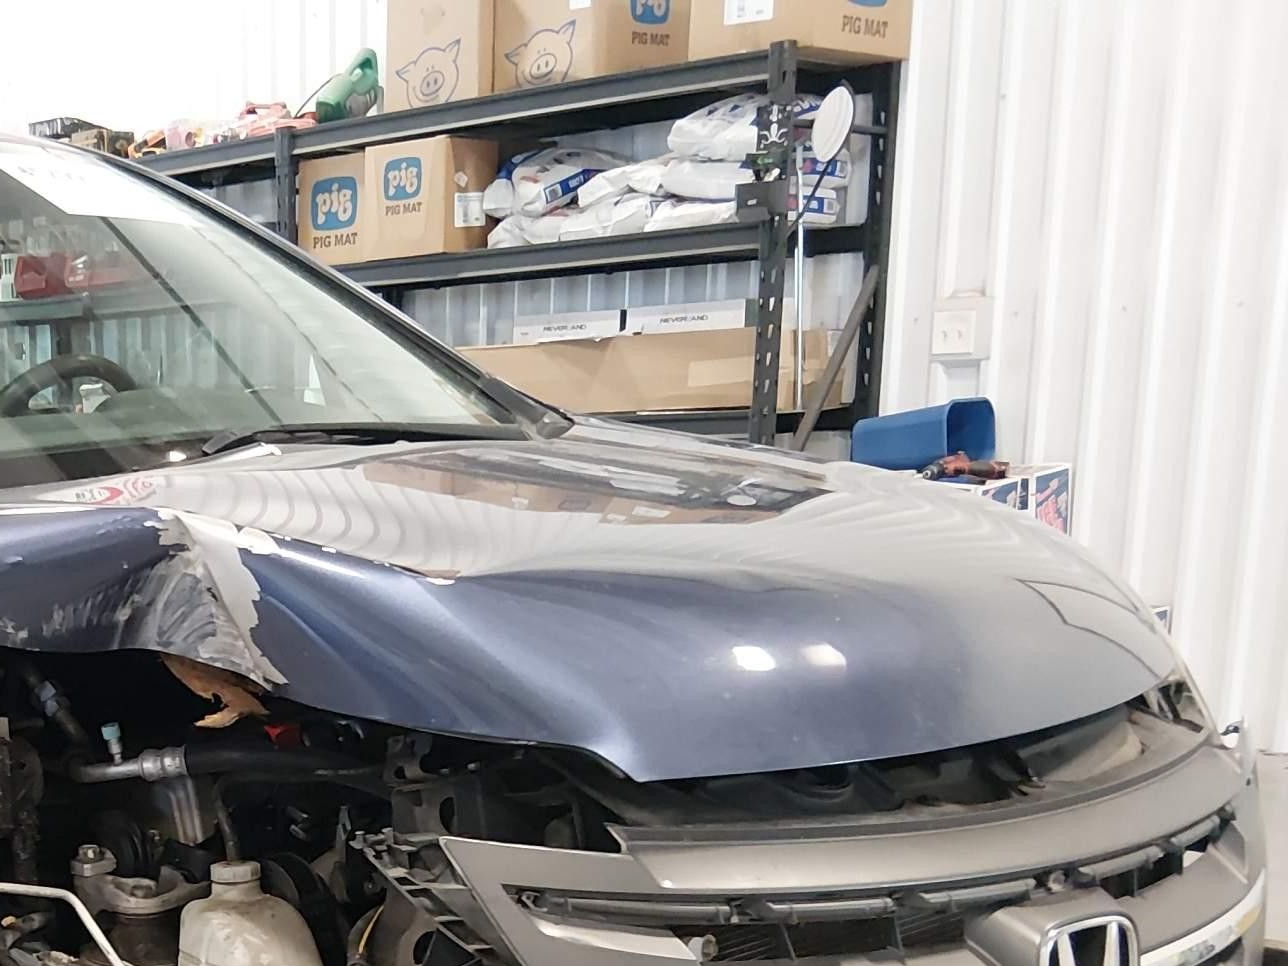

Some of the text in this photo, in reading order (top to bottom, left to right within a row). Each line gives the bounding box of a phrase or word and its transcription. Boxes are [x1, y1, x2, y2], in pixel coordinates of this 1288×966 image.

[841, 15, 888, 39] PIG MAT
[631, 31, 670, 46] PIG MAT
[387, 161, 418, 196] pig
[315, 182, 353, 225] pig
[385, 202, 423, 216] PIG MAT
[313, 232, 358, 249] PIG MAT
